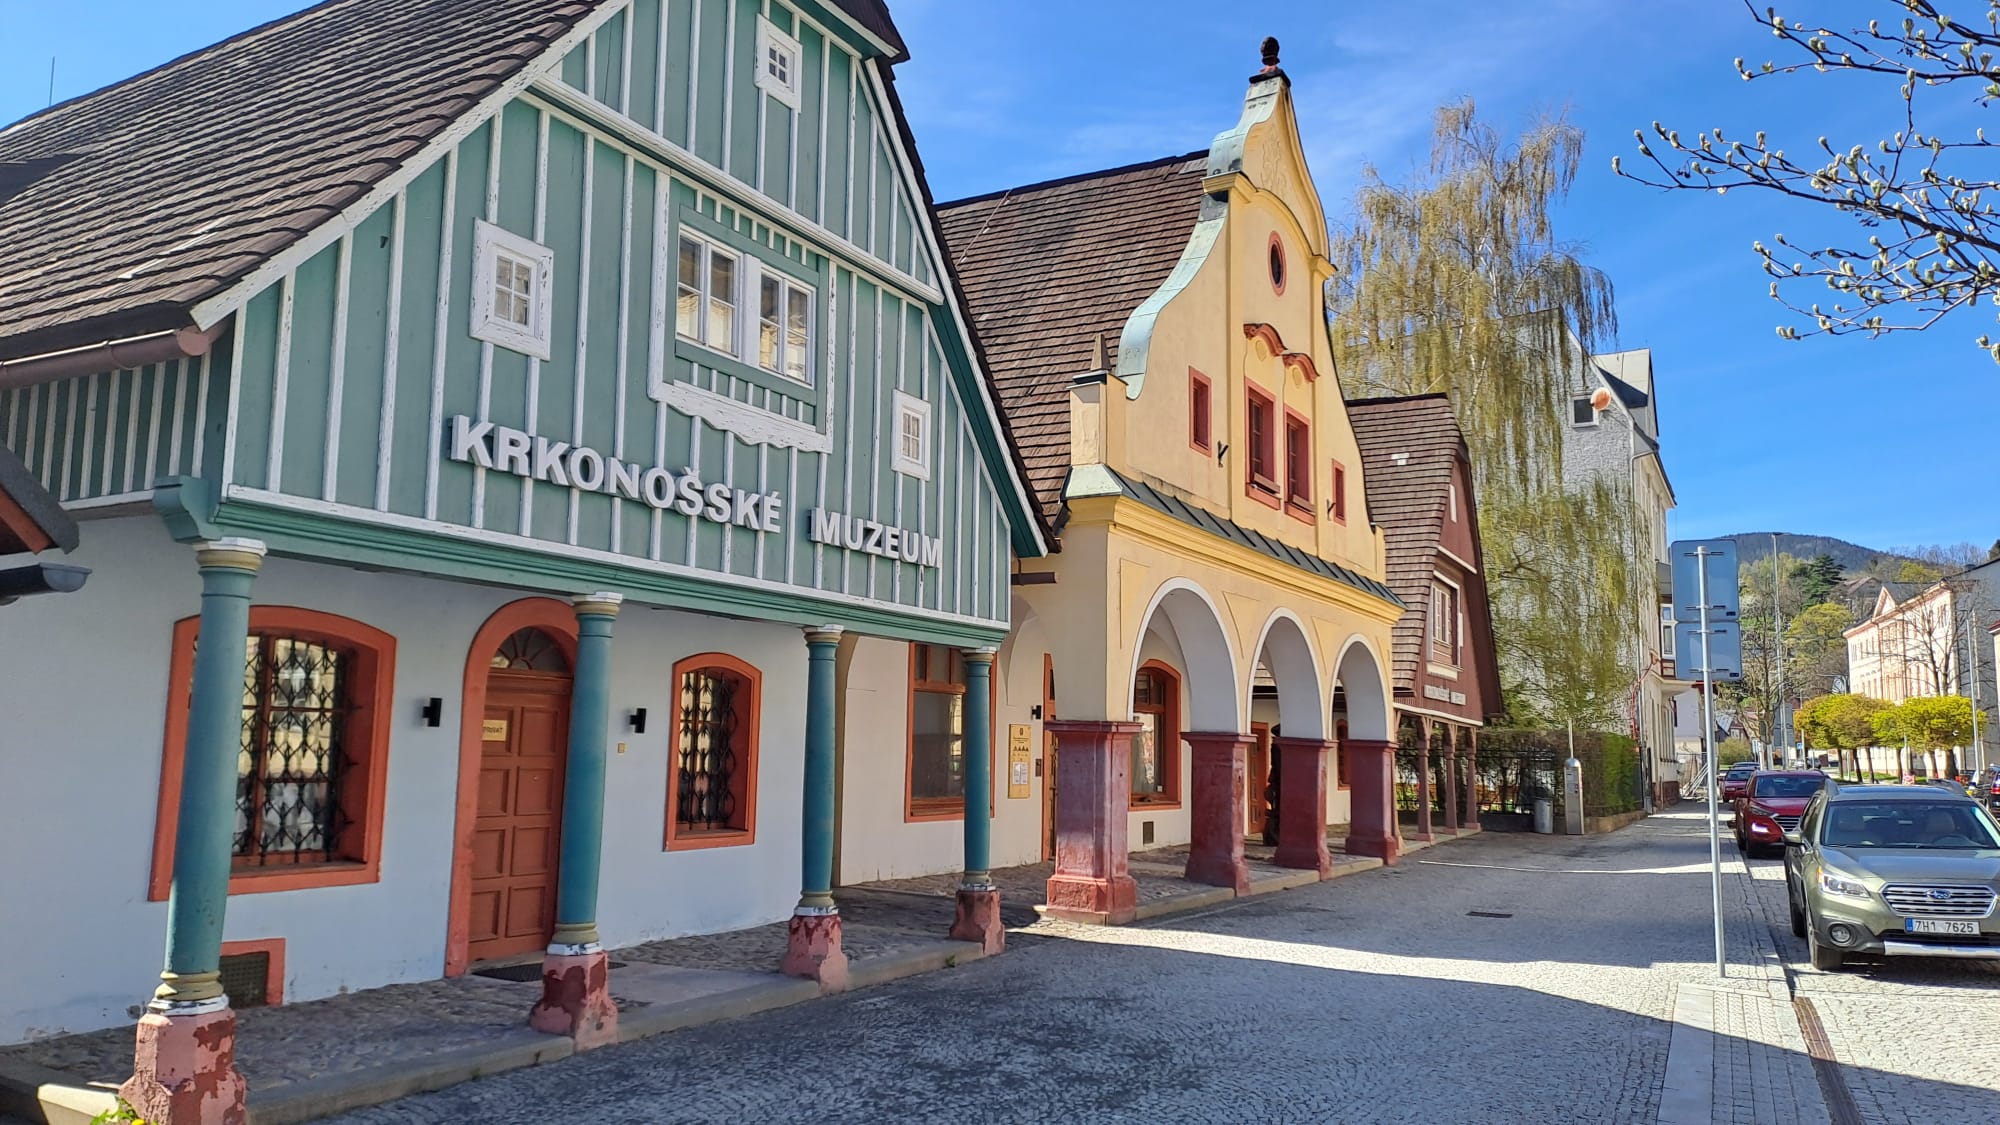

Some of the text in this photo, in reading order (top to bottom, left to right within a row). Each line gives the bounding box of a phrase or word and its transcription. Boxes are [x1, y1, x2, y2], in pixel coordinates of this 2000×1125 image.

[450, 414, 943, 569] KRKONOŠSKÉ MUZEUM
[1915, 920, 1974, 933] 7H1 7625
